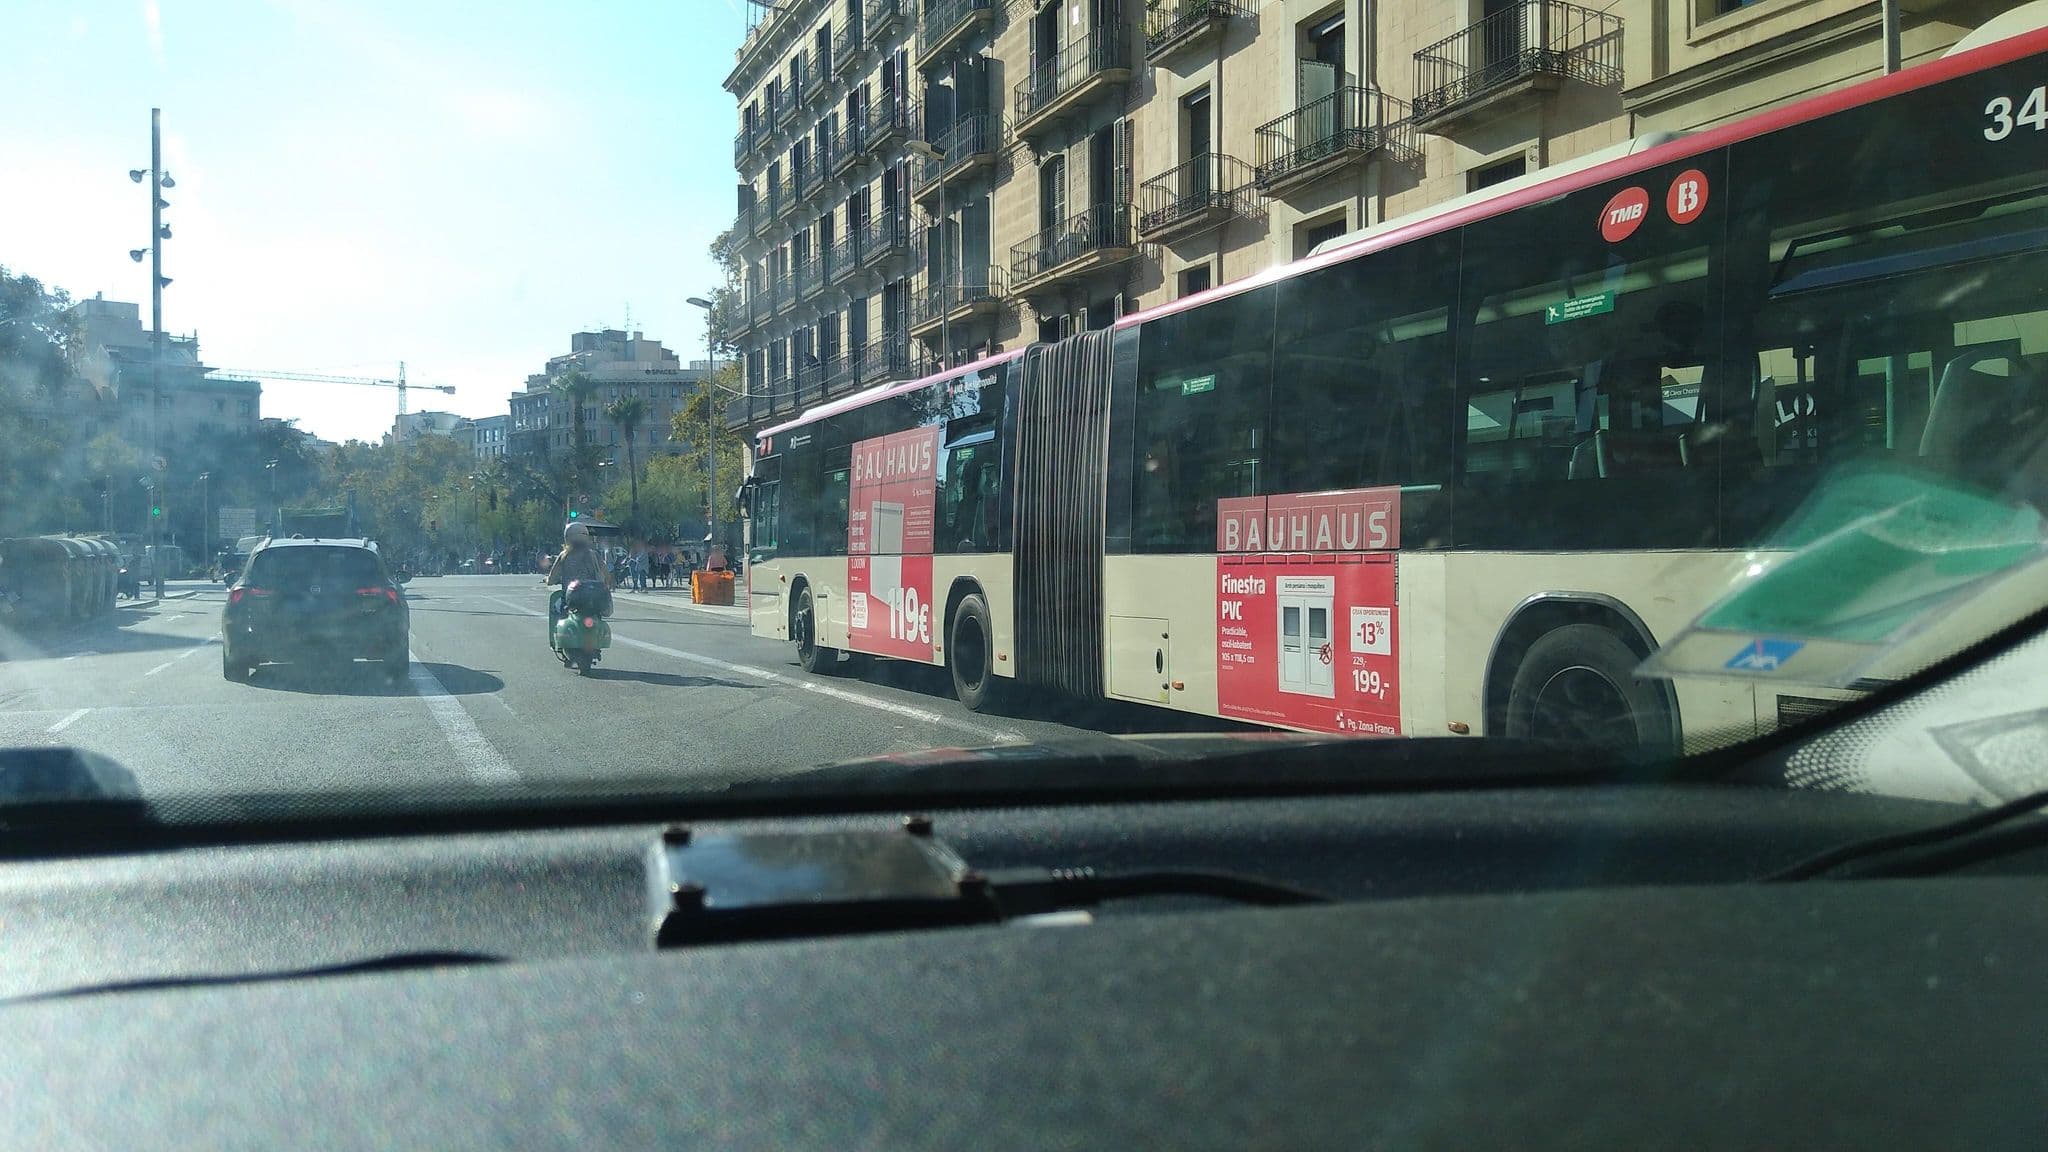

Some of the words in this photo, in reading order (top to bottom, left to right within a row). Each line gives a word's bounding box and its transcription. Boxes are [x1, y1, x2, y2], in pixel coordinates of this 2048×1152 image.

[1983, 85, 2048, 142] 34
[1677, 180, 1699, 214] B
[1609, 203, 1644, 226] TMB
[1225, 511, 1388, 551] BAUHAUS
[1222, 573, 1266, 595] Finestra
[887, 586, 930, 644] 119€
[1222, 600, 1243, 620] PVC
[1356, 621, 1385, 645] -13%
[1352, 669, 1390, 701] 199,-
[1347, 718, 1358, 732] Pg.
[1358, 720, 1374, 732] Zona
[1374, 722, 1395, 735] Franca
